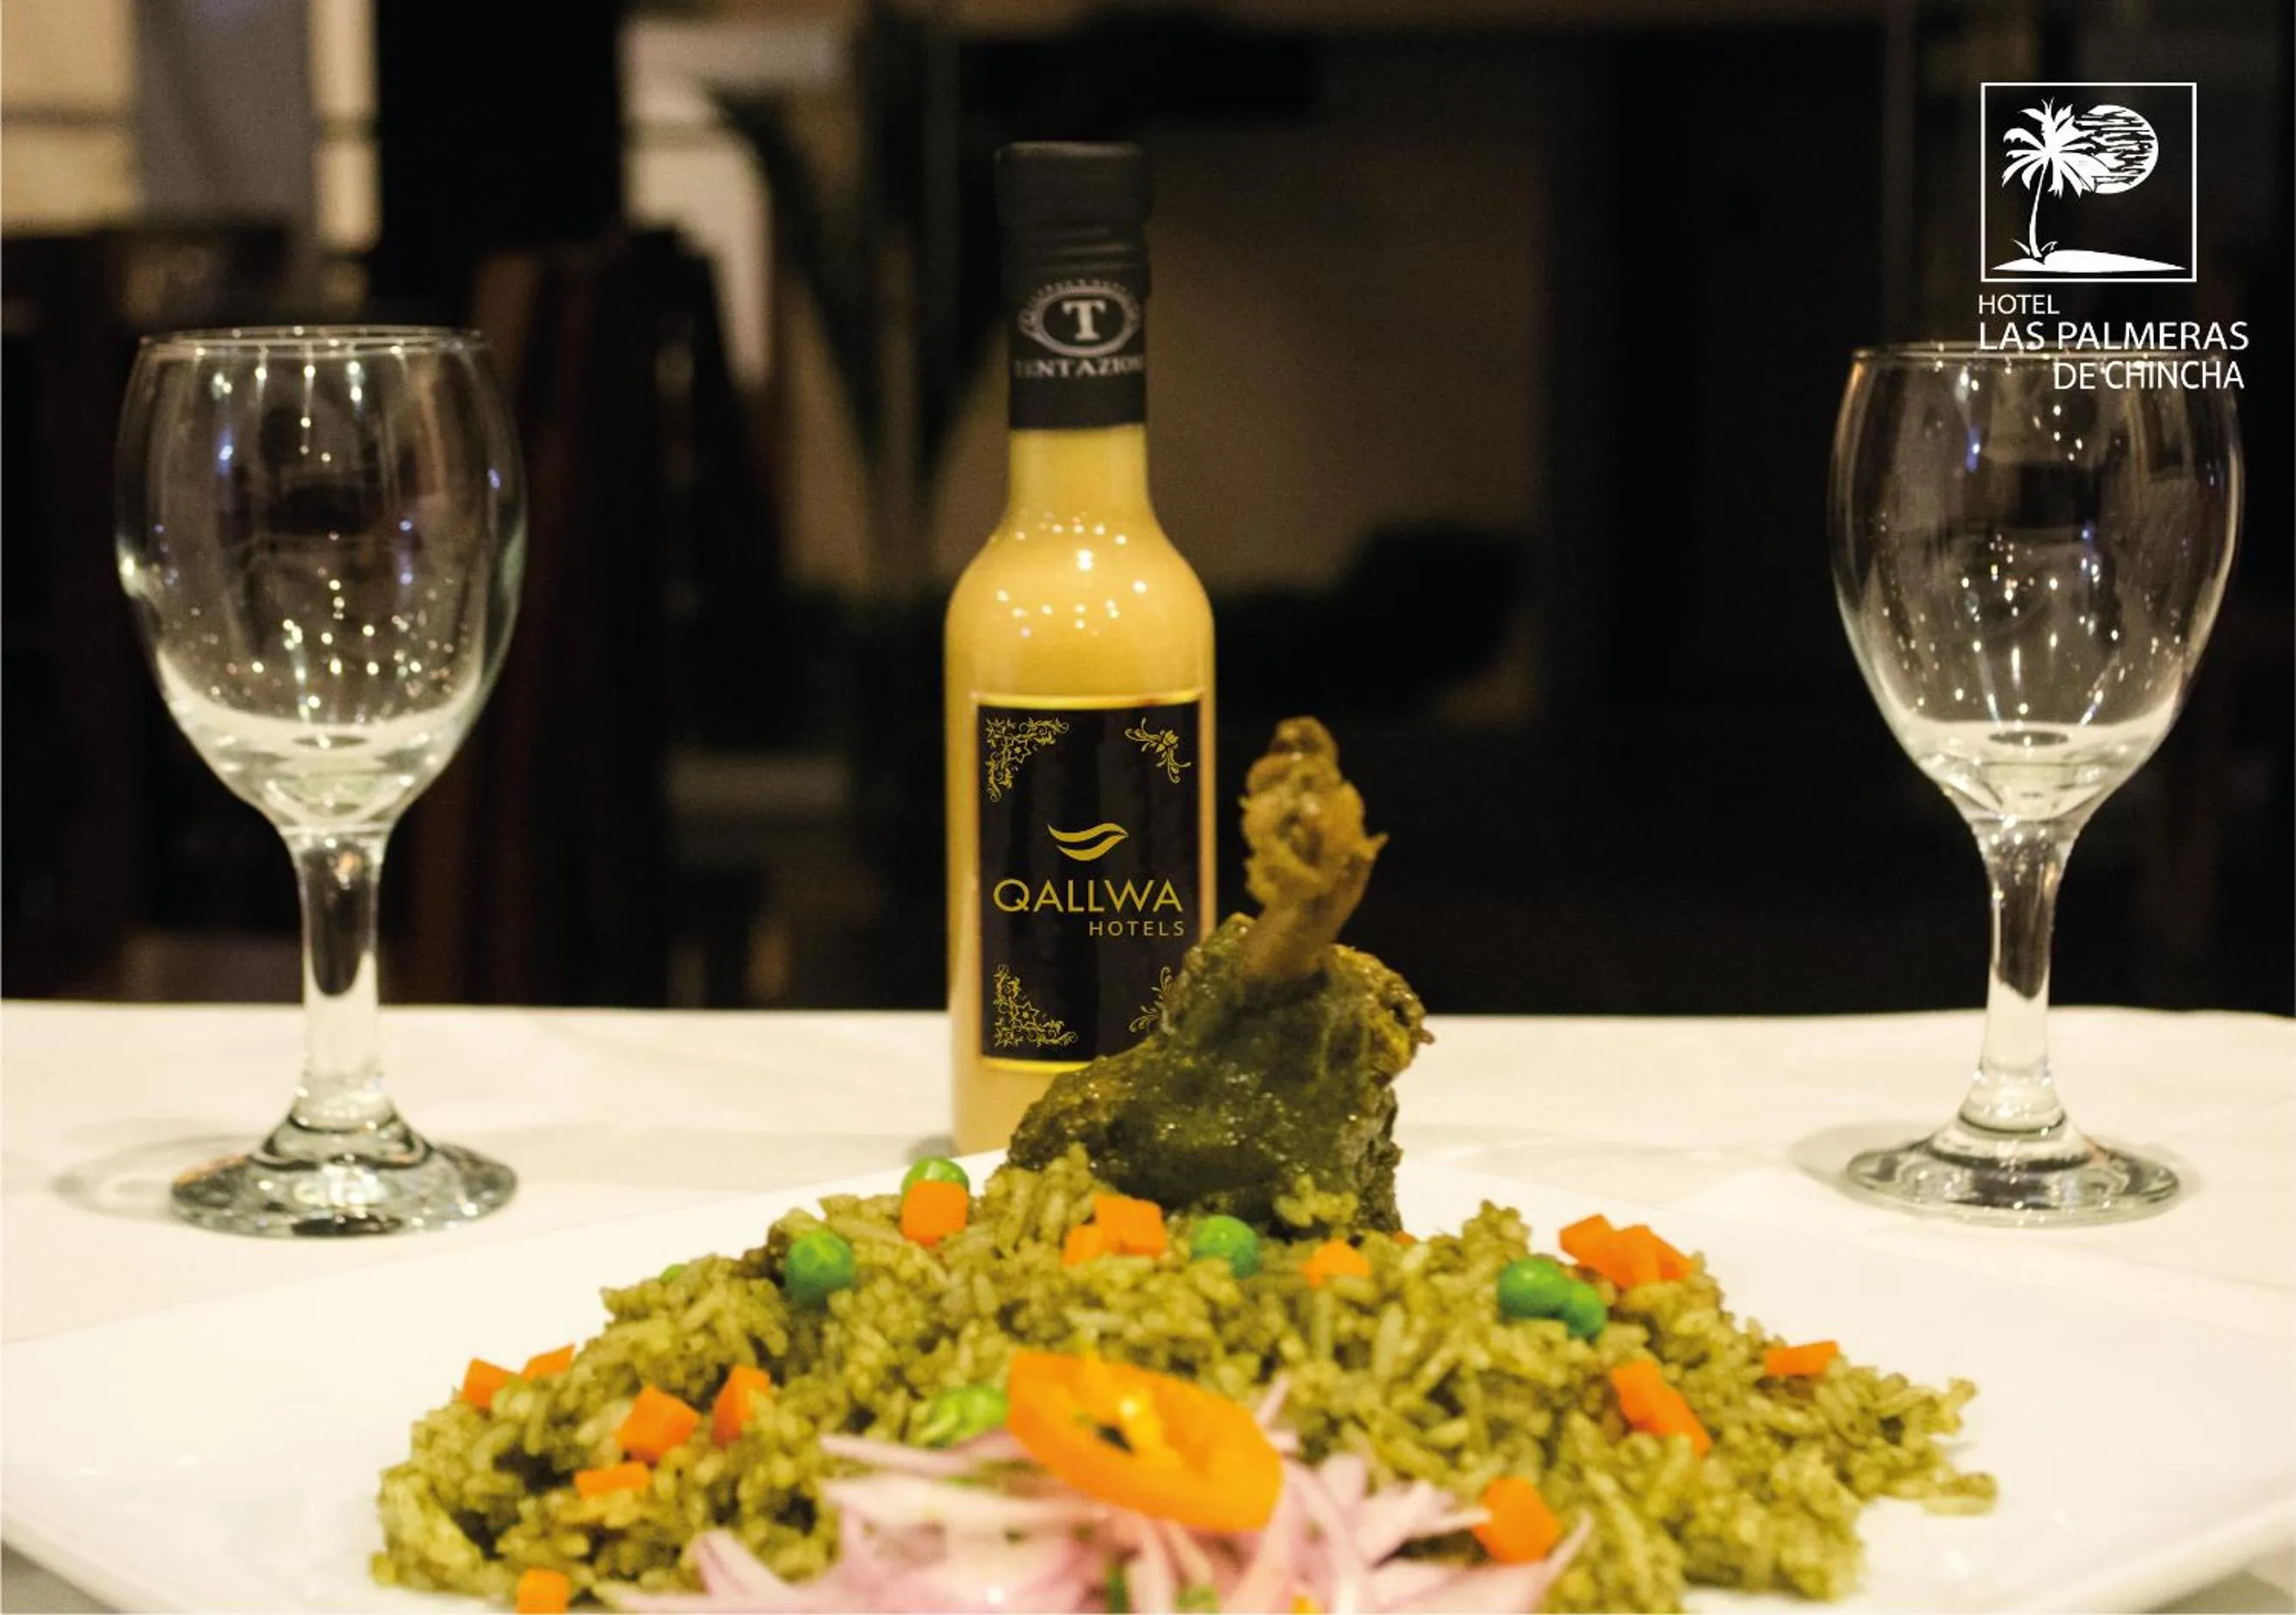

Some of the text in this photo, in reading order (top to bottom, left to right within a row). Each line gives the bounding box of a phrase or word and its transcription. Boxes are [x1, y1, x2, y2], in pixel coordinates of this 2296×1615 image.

[1061, 300, 1107, 340] T
[993, 878, 1184, 913] QALLWA
[1089, 921, 1185, 937] HOTELS
